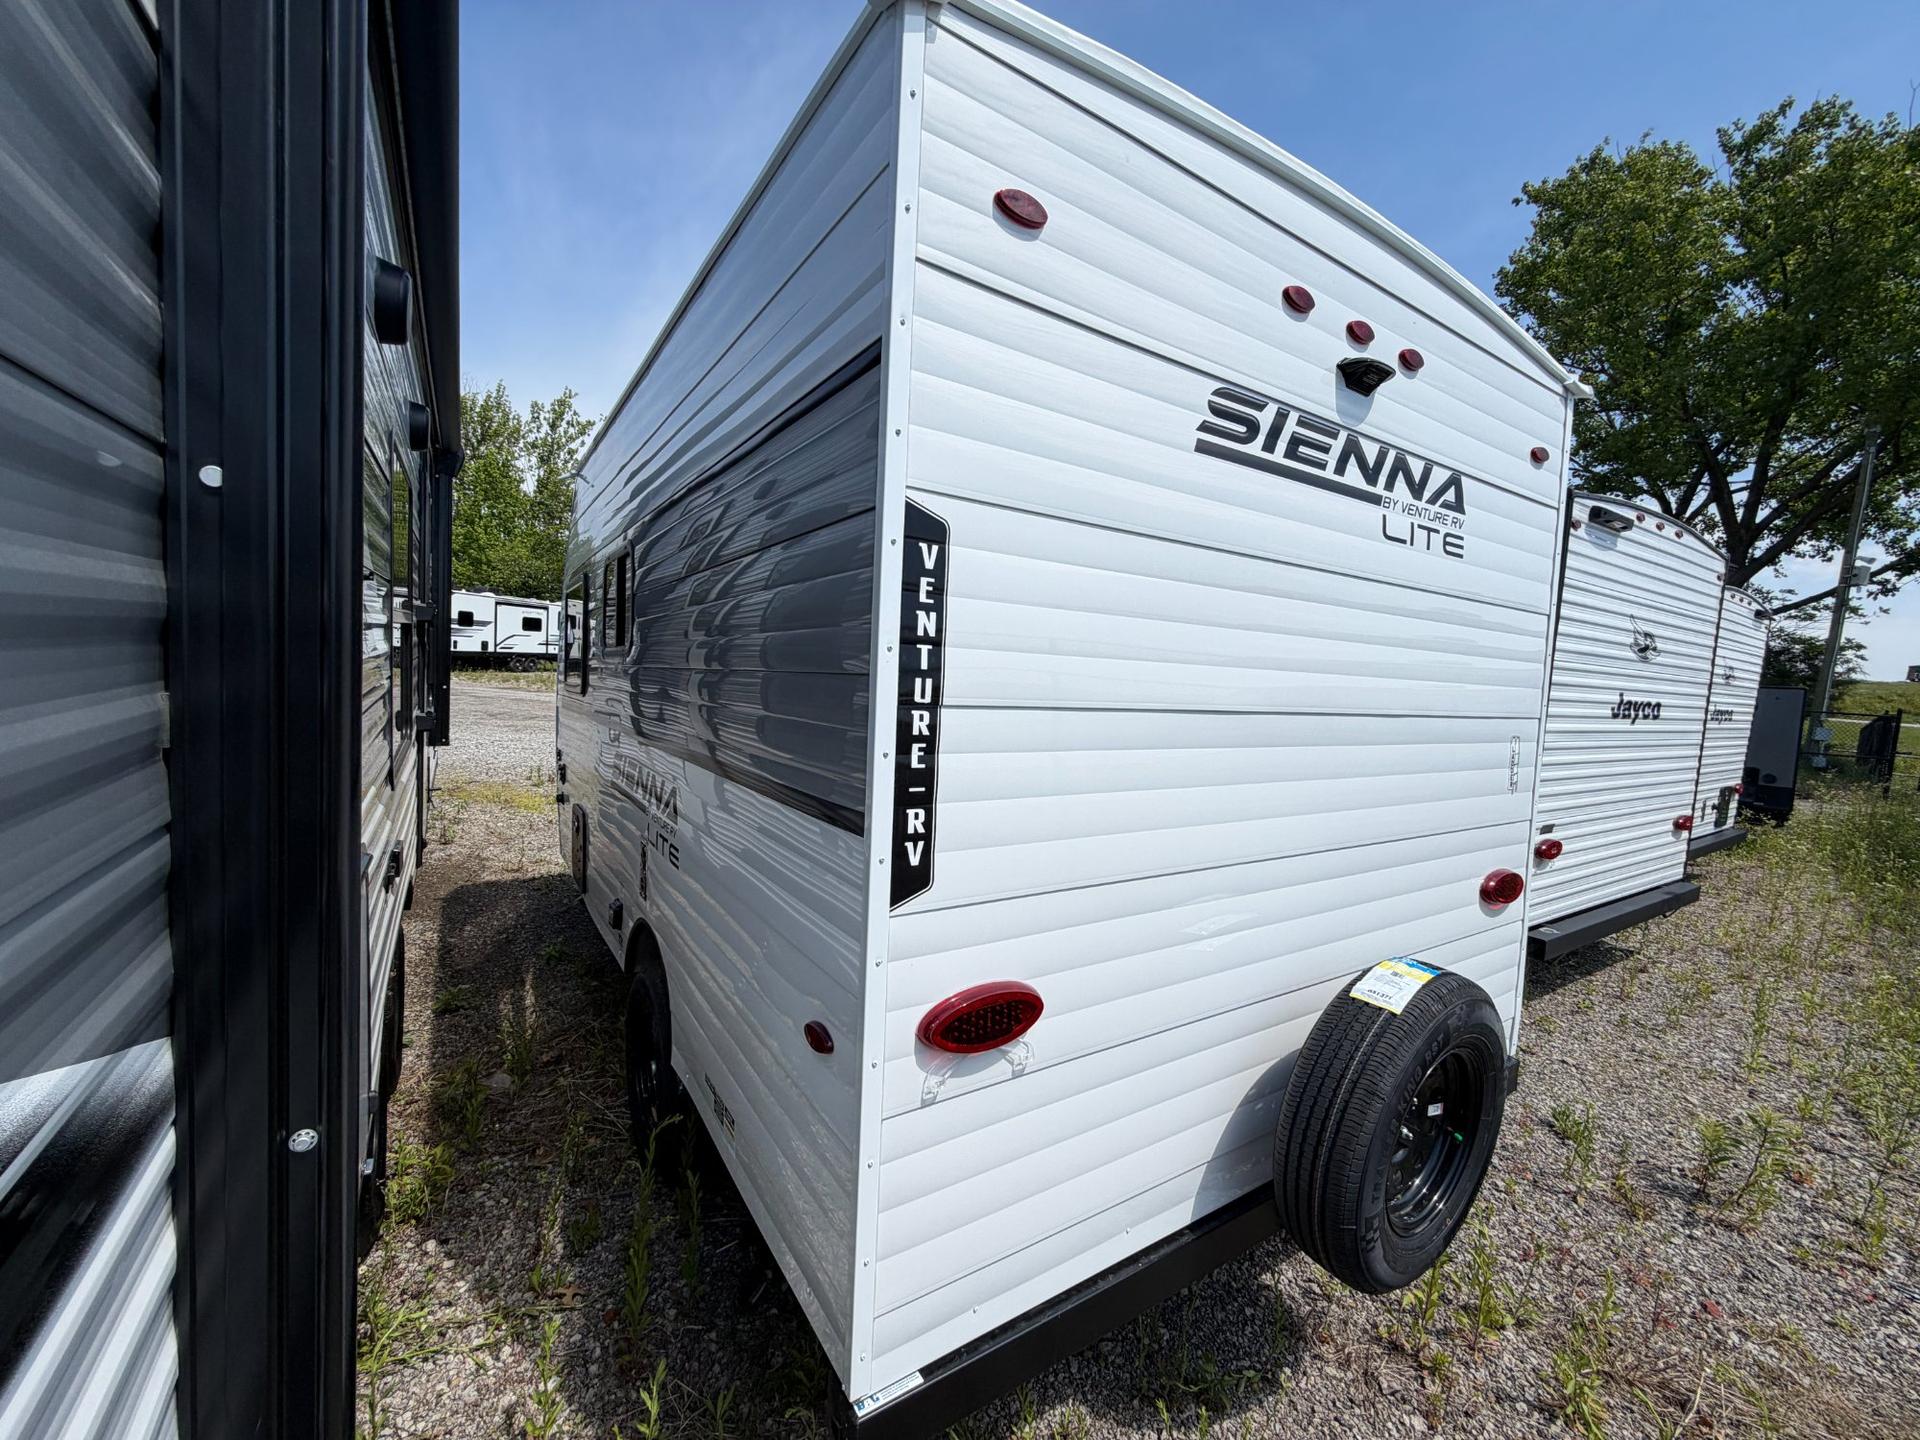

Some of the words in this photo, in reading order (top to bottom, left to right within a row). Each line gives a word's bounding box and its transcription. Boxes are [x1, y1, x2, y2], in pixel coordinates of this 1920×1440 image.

[1195, 386, 1466, 515] SIENNA
[1382, 496, 1399, 509] BY
[1401, 502, 1450, 526] VENTURE
[1450, 512, 1465, 530] RV
[1382, 514, 1464, 559] LITE
[1611, 692, 1662, 725] Jayco
[611, 752, 679, 826] SIENNA
[647, 822, 680, 871] LITE
